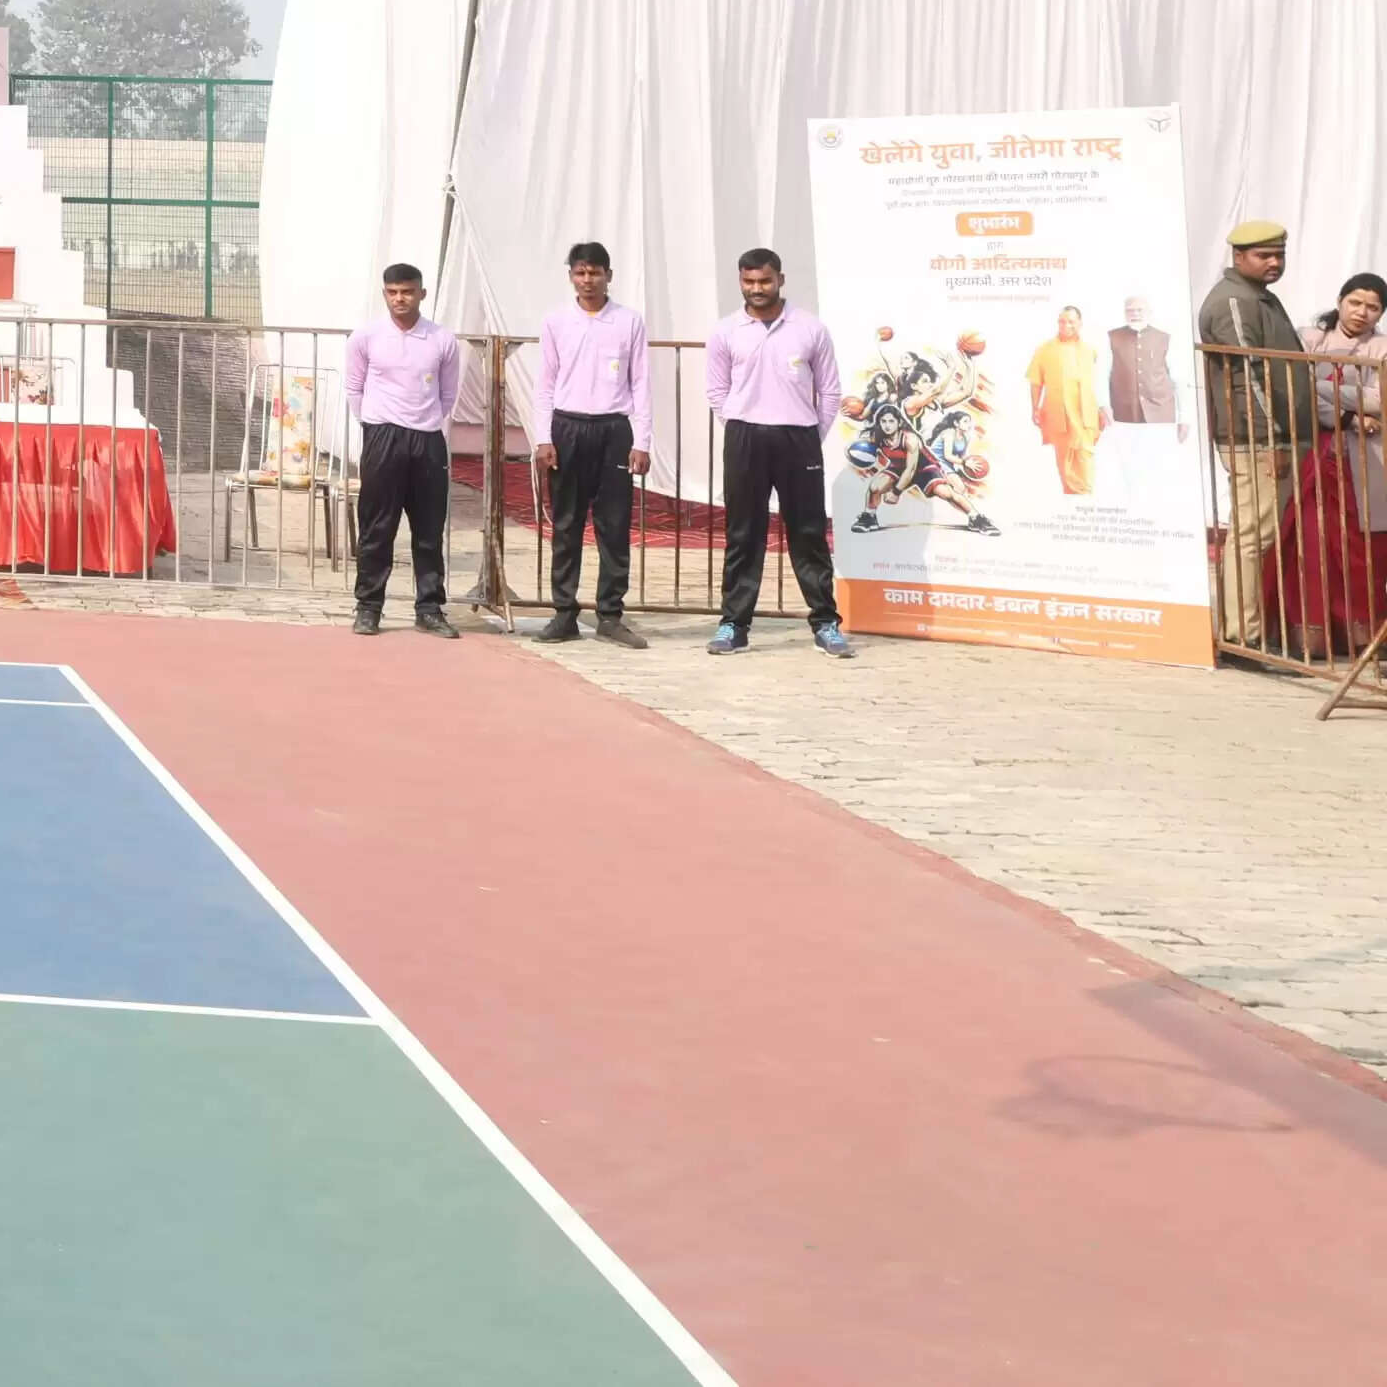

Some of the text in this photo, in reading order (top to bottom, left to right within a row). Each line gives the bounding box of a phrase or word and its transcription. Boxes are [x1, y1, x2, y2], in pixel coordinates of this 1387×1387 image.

[859, 133, 1124, 170] खेलेंगे युवा, जीतेगा राष्ट्र
[967, 214, 1020, 235] शुभारंभ
[930, 253, 1068, 271] योगी आदित्यनाथ
[998, 276, 1020, 287] उत्तर
[1023, 274, 1052, 287] प्रदेश
[882, 587, 1162, 629] काम दमदार-डबल इंजन सरकार
